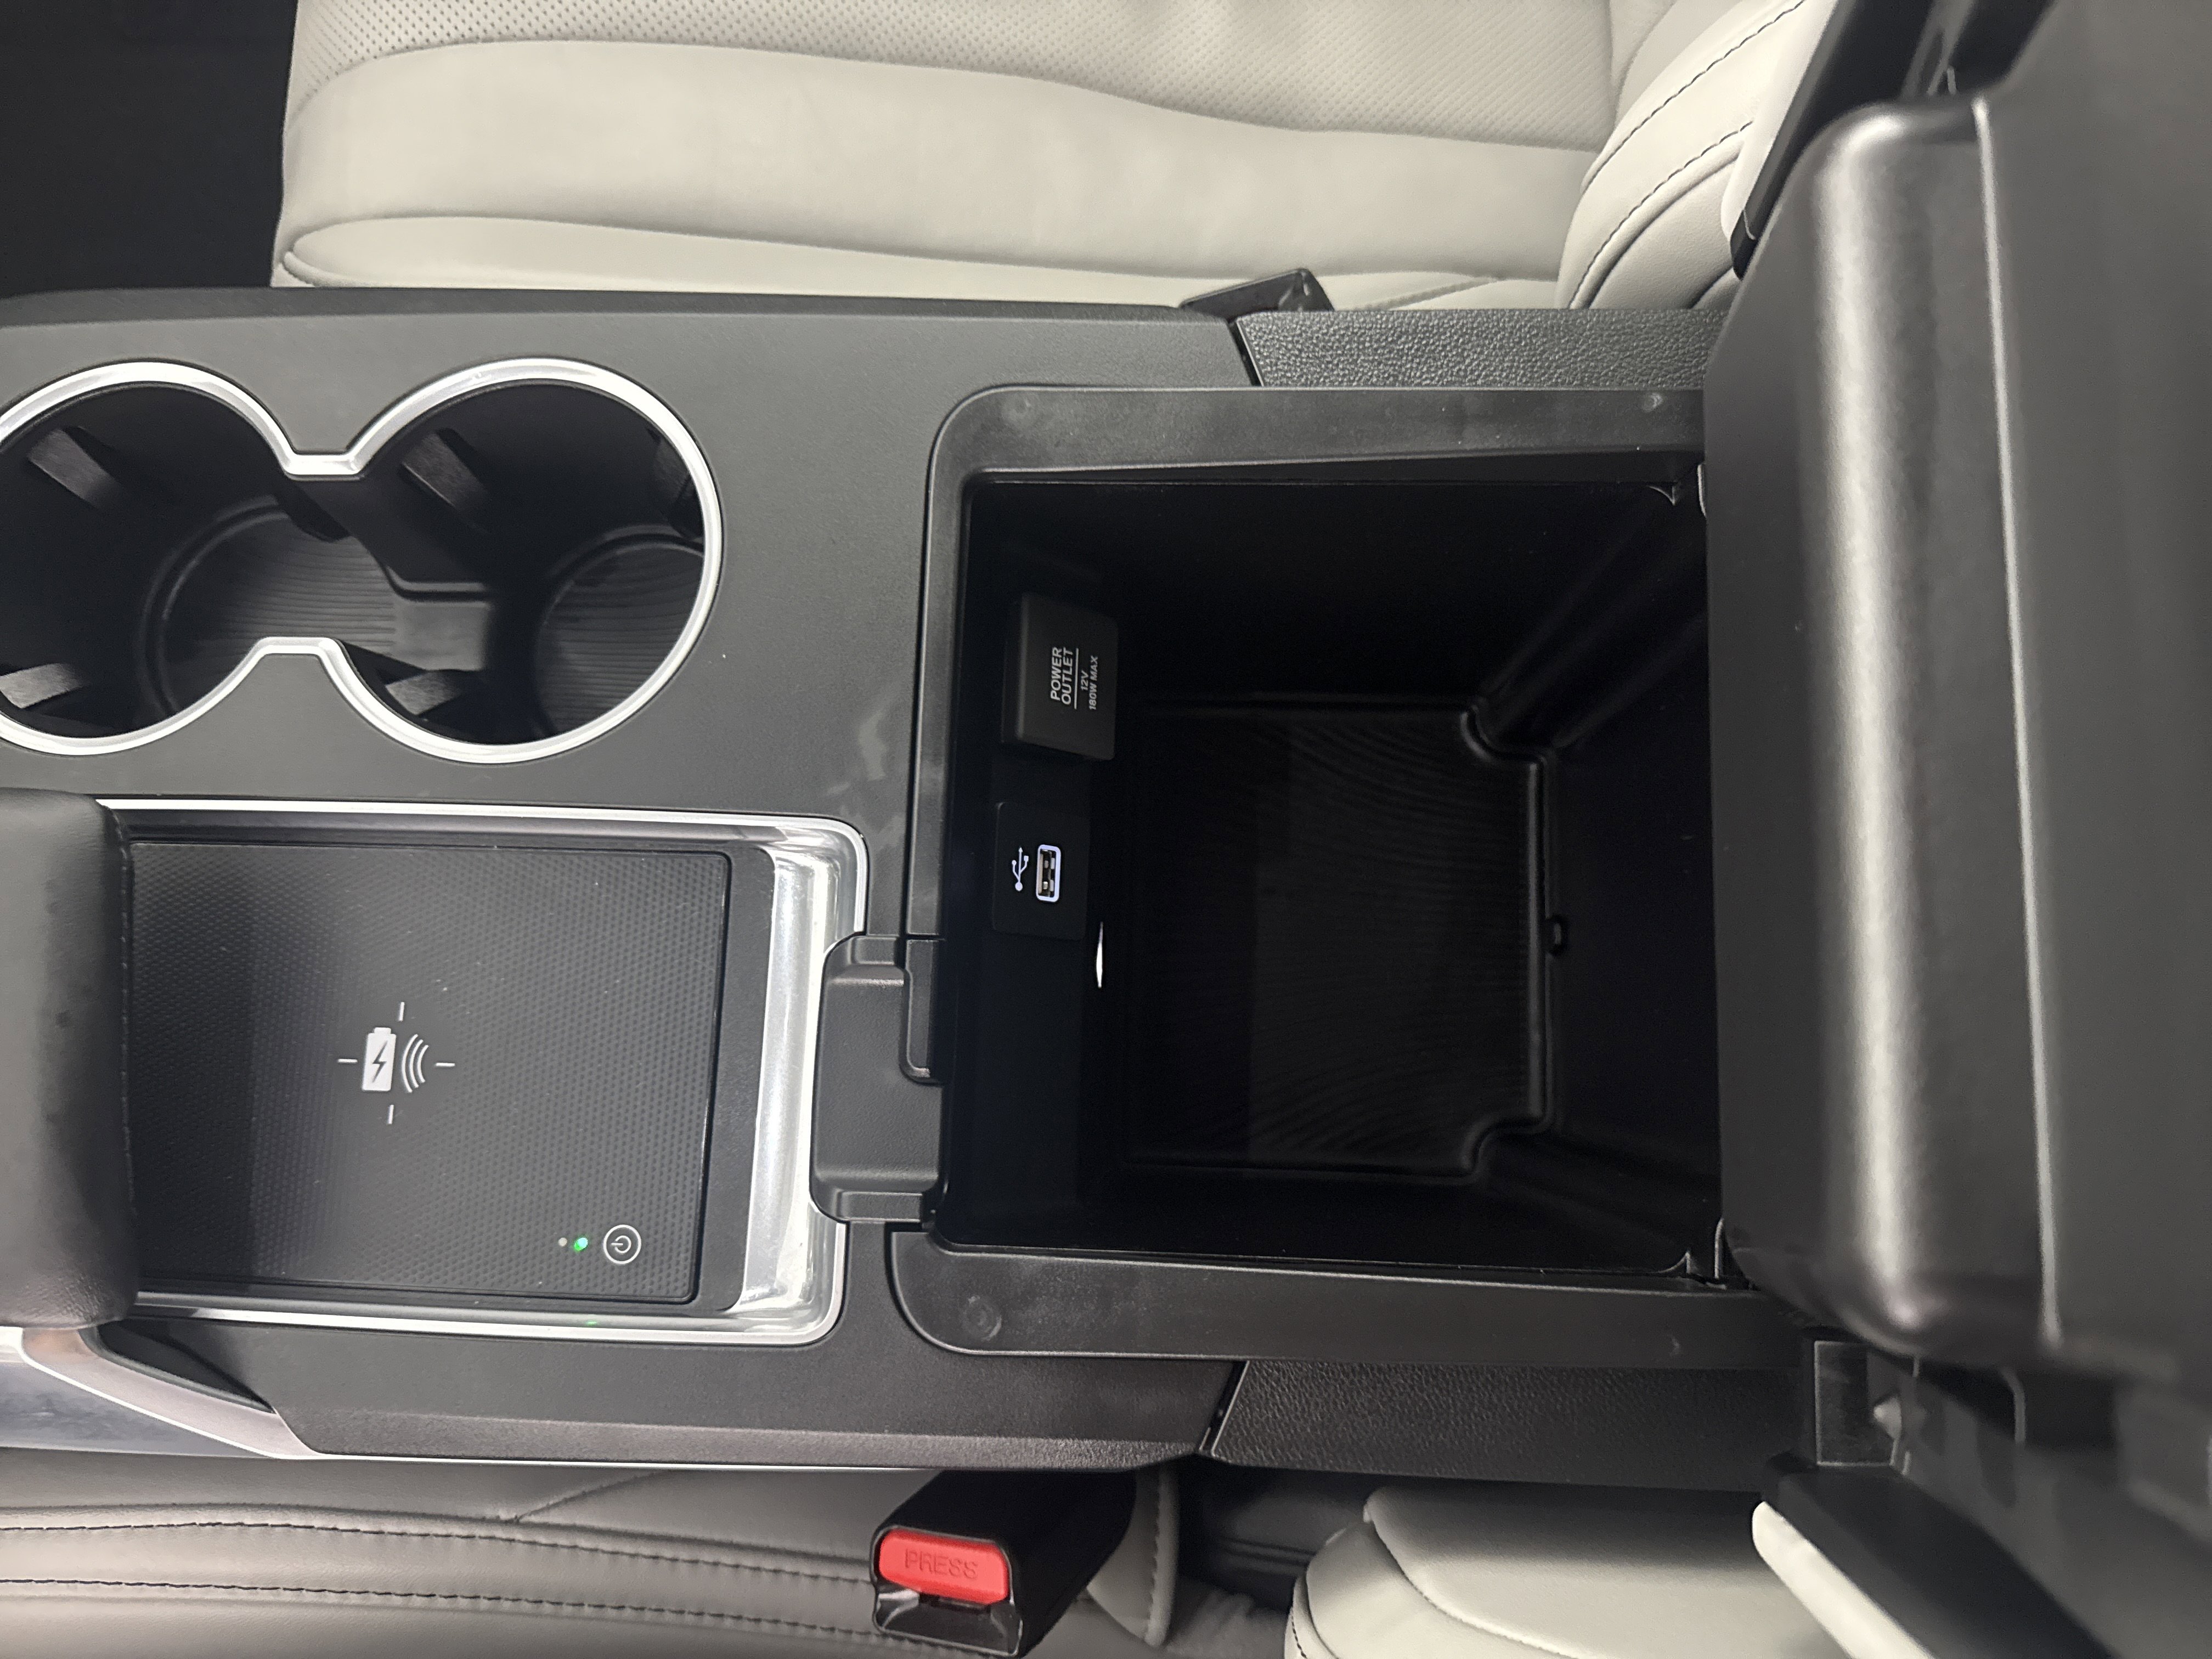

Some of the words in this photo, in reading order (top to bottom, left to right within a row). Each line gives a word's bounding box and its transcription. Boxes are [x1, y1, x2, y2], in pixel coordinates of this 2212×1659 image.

[1051, 647, 1062, 701] POWER
[1062, 647, 1073, 705] OUTLET
[1081, 670, 1089, 691] 12V
[1090, 656, 1098, 681] MAX
[1089, 682, 1097, 710] 180W
[905, 1548, 978, 1579] PRESS
